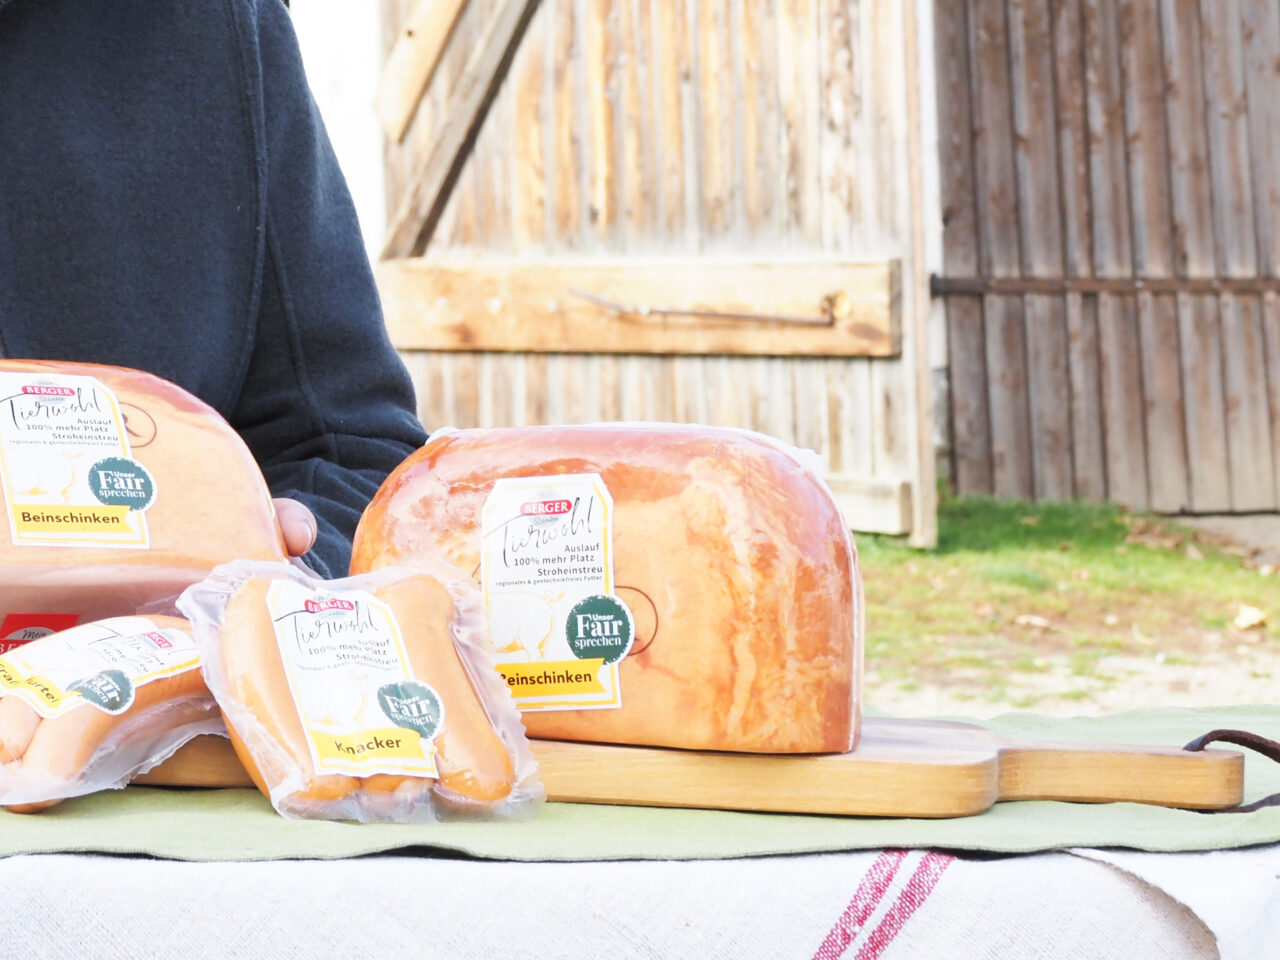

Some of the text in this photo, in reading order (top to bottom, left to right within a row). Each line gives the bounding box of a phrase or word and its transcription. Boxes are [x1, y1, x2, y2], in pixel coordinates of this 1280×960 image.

[26, 385, 72, 396] BERGER
[77, 418, 112, 426] Auslauf
[84, 425, 109, 433] Platz
[52, 433, 119, 442] Stroheinstreu
[97, 470, 145, 490] Fair
[99, 488, 146, 499] sprechen
[524, 501, 569, 514] BERGER
[21, 512, 120, 524] Beinschinken
[484, 496, 593, 568] Tierwohl
[564, 542, 600, 553] Auslauf
[514, 554, 595, 566] 100% mehr Platz
[537, 565, 603, 577] Stroheinstreu
[307, 599, 353, 613] BERGER
[592, 613, 615, 621] Unser
[575, 614, 623, 639] Fair
[574, 636, 622, 649] sprechen
[308, 644, 337, 656] 100%
[384, 694, 431, 718] Fair
[334, 736, 402, 755] Knacker
